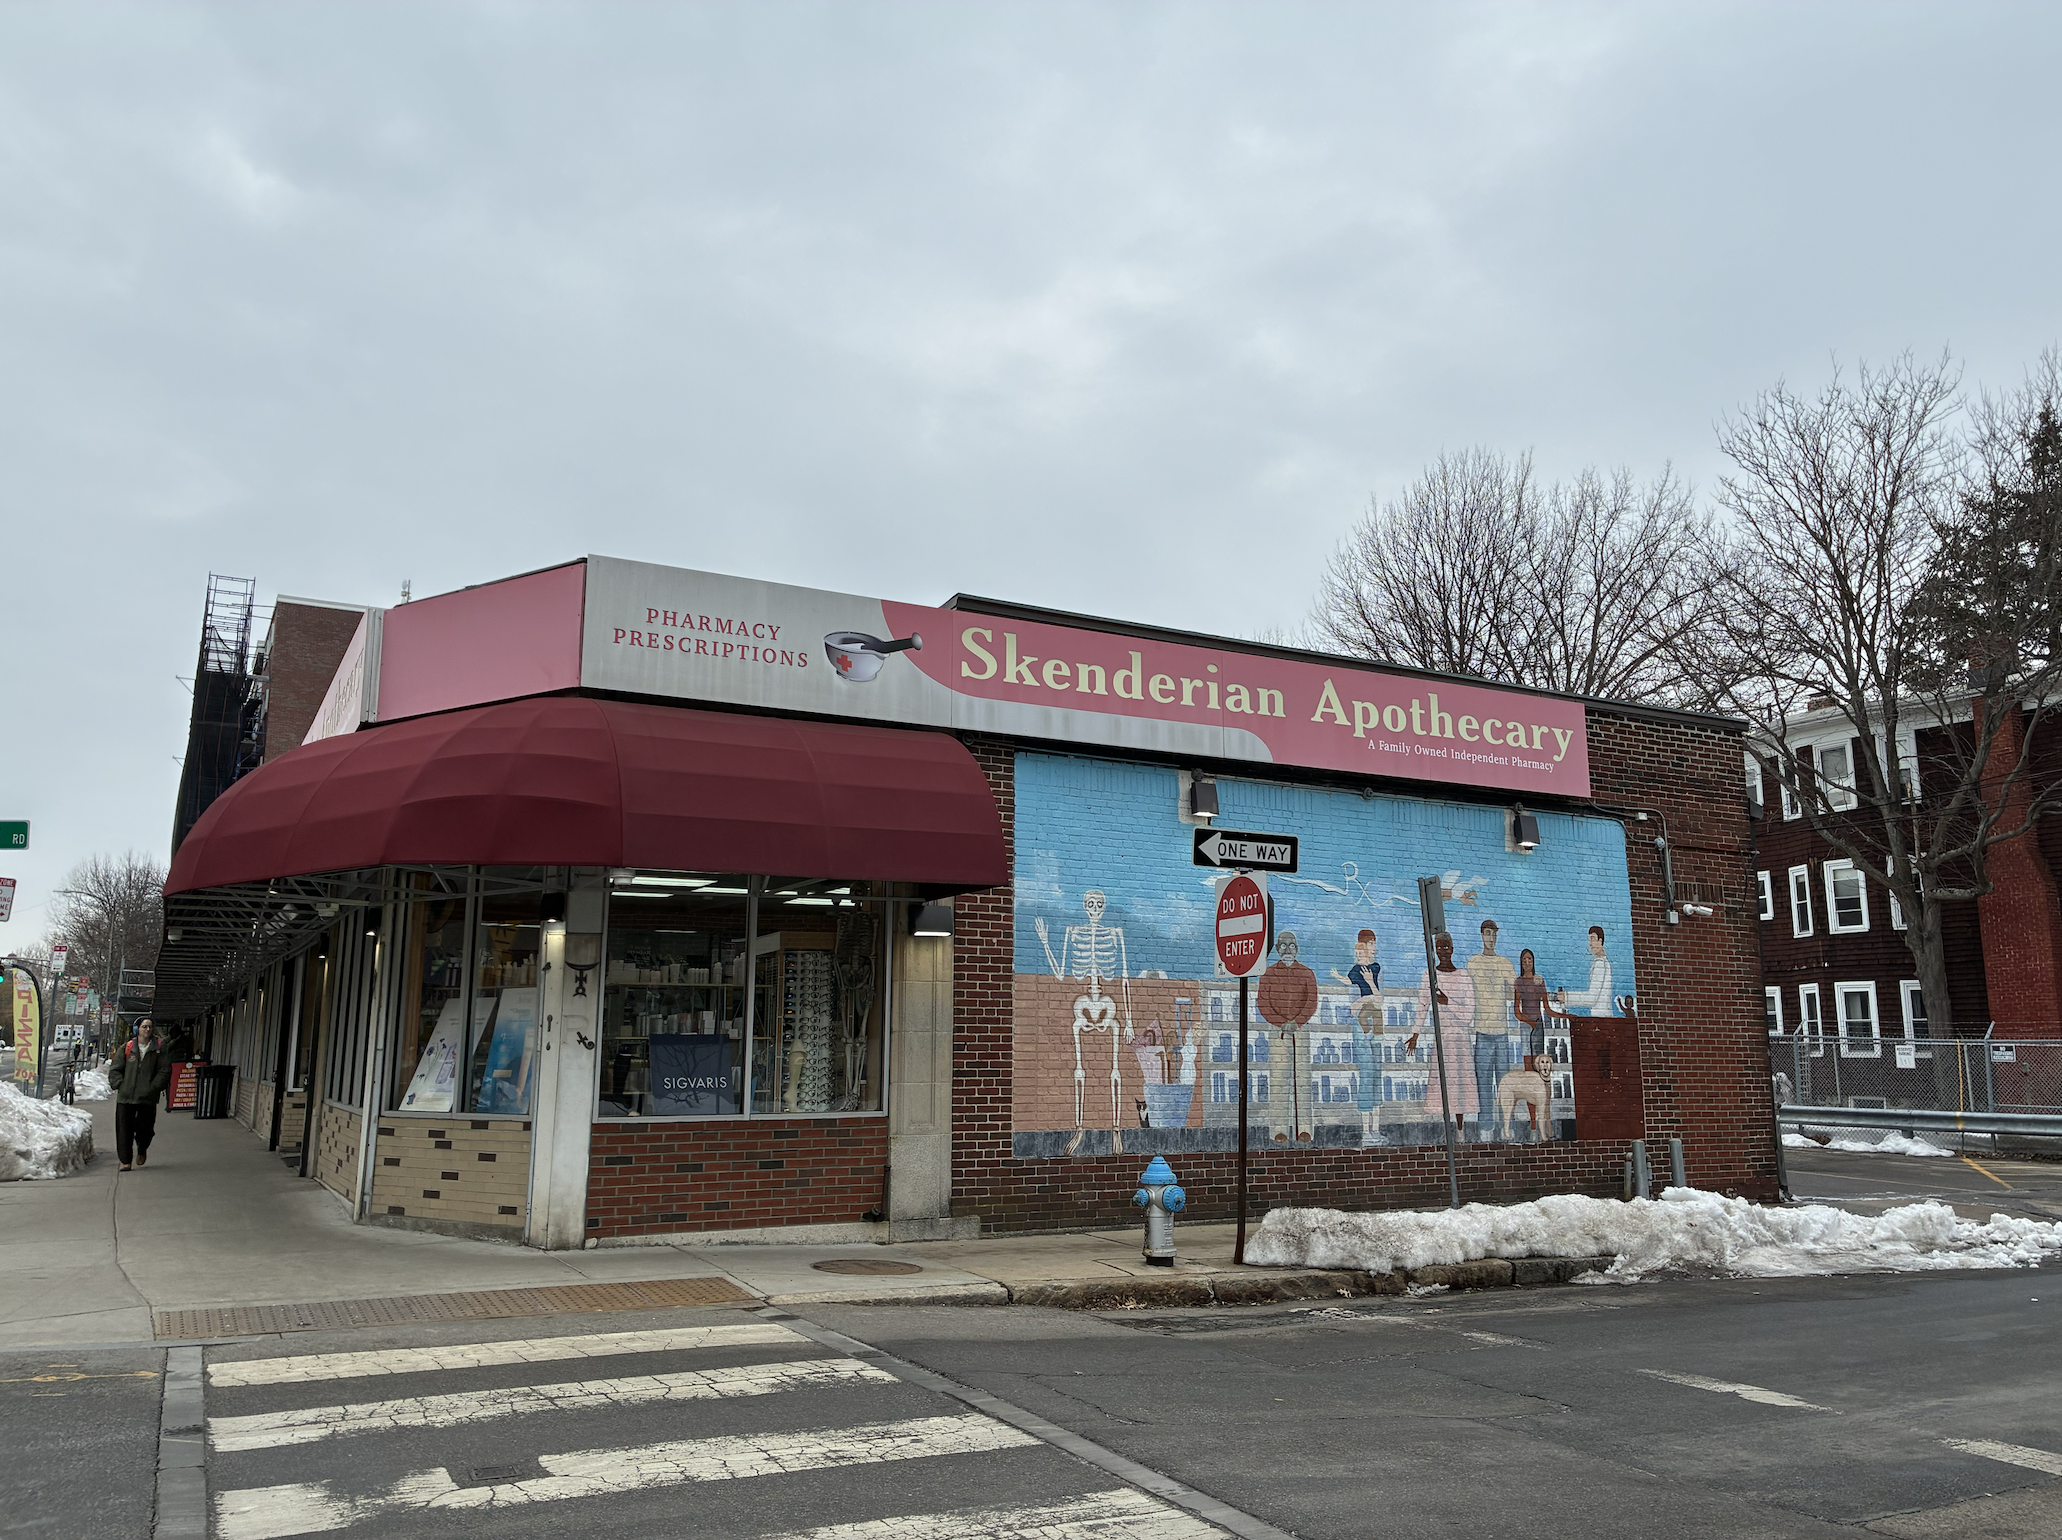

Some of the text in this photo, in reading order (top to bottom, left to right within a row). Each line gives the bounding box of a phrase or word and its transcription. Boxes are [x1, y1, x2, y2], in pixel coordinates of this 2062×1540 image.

[646, 607, 782, 641] PHARMACY
[613, 628, 809, 669] PRESCRIPTIONS
[960, 627, 1574, 762] Skenderian Apothecary
[1368, 739, 1555, 773] A Family Owned Independent Pharmacy
[12, 833, 26, 845] RD
[1217, 842, 1288, 861] ONE WAY
[1222, 893, 1259, 914] DO NOT
[1225, 939, 1255, 957] ENTER
[663, 1076, 728, 1090] SIGVARIS
